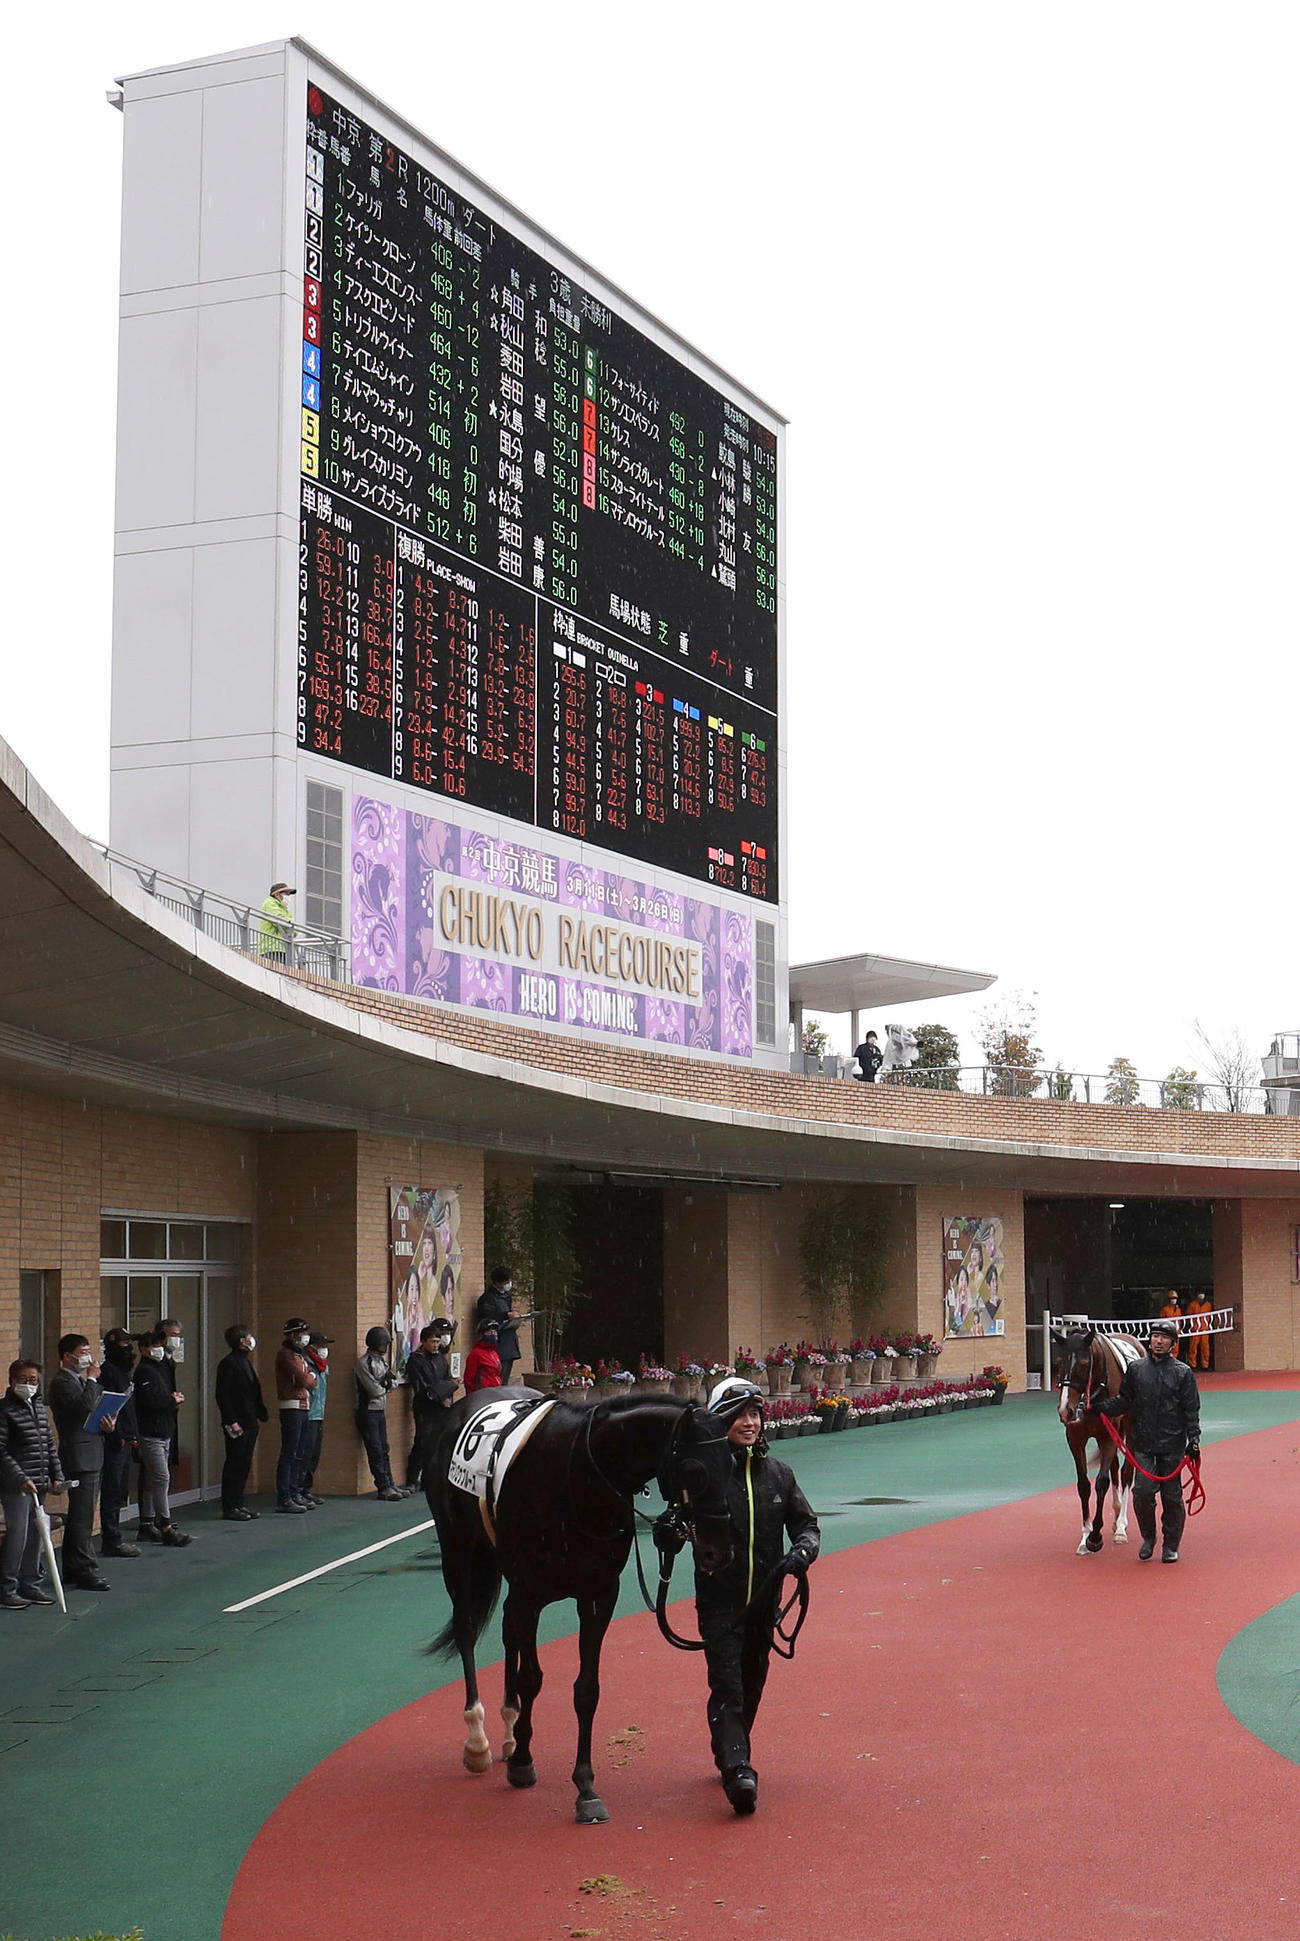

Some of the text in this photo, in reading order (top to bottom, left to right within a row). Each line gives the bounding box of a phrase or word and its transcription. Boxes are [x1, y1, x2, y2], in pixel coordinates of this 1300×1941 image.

[330, 135, 351, 166] 馬番
[422, 204, 452, 241] 馬体重
[453, 227, 481, 262] 前回差
[548, 297, 580, 333] 負担重量
[332, 107, 361, 147] 中京
[416, 170, 454, 217] 1200m
[462, 206, 495, 245] ダート
[550, 270, 571, 305] 3歳
[579, 294, 611, 334] 未勝利
[337, 172, 341, 193] 1
[430, 241, 452, 270] 406
[501, 285, 524, 321] 角田
[534, 309, 547, 337] 和
[553, 326, 578, 359] 53.0
[333, 269, 341, 289] 4
[429, 331, 451, 359] 464
[499, 371, 523, 405] 岩田
[533, 393, 546, 422] 望
[553, 409, 578, 440] 56.0
[334, 202, 343, 226] 2
[430, 271, 452, 300] 468
[500, 313, 523, 350] 秋山
[534, 337, 546, 365] 稔
[553, 354, 578, 386] 55.0
[334, 234, 342, 257] 3
[430, 301, 452, 329] 460
[457, 323, 478, 348] -12
[499, 342, 523, 377] 菱田
[553, 381, 578, 413] 56.0
[332, 298, 341, 321] 5
[429, 361, 451, 390] 432
[499, 400, 523, 435] 永島
[552, 437, 577, 467] 52.0
[332, 331, 340, 353] 6
[428, 389, 450, 419] 514
[464, 406, 477, 436] 初
[499, 428, 523, 462] 国分
[533, 449, 545, 478] 優
[552, 464, 577, 495] 56.0
[332, 363, 340, 385] 7
[428, 422, 450, 449] 406
[498, 456, 523, 492] 的場
[552, 492, 577, 522] 54.0
[599, 359, 608, 380] 11
[756, 471, 774, 497] 54.0
[301, 482, 351, 533] 単勝 WIN
[330, 428, 339, 451] 9
[427, 482, 449, 509] 448
[462, 495, 476, 525] 初
[498, 515, 522, 549] 柴田
[532, 534, 544, 561] 善
[552, 548, 577, 577] 54.0
[331, 396, 339, 418] 8
[427, 452, 450, 479] 418
[463, 466, 476, 496] 初
[498, 485, 522, 519] 松本
[552, 520, 577, 550] 55.0
[598, 439, 609, 460] 14
[688, 499, 703, 521] +18
[718, 514, 735, 542] 北村
[742, 530, 751, 553] 友
[756, 541, 774, 566] 56.0
[599, 386, 609, 408] 12
[718, 466, 735, 494] 小林
[756, 494, 774, 520] 53.0
[599, 413, 609, 434] 13
[718, 490, 735, 519] 小崎
[755, 518, 774, 543] 54.0
[753, 443, 775, 473] 10:15
[323, 458, 338, 483] 10
[427, 511, 449, 540] 512
[497, 545, 521, 577] 岩田
[532, 564, 545, 591] 康
[552, 576, 577, 605] 56.0
[397, 530, 475, 592] 複勝 PLACE-SHOW
[598, 466, 609, 487] 15
[688, 524, 703, 546] +10
[718, 539, 735, 566] 丸山
[756, 565, 774, 589] 56.0
[598, 493, 609, 514] 16
[756, 588, 774, 613] 53.0
[553, 608, 575, 641] 枠連
[608, 592, 753, 689] 馬場状態 芝 重 ダート 重
[482, 841, 558, 898] 中京競馬
[441, 884, 702, 998] CHUKYO RACECOURSE
[520, 974, 638, 1033] HERO IS COMING.
[456, 1405, 502, 1462] 16
